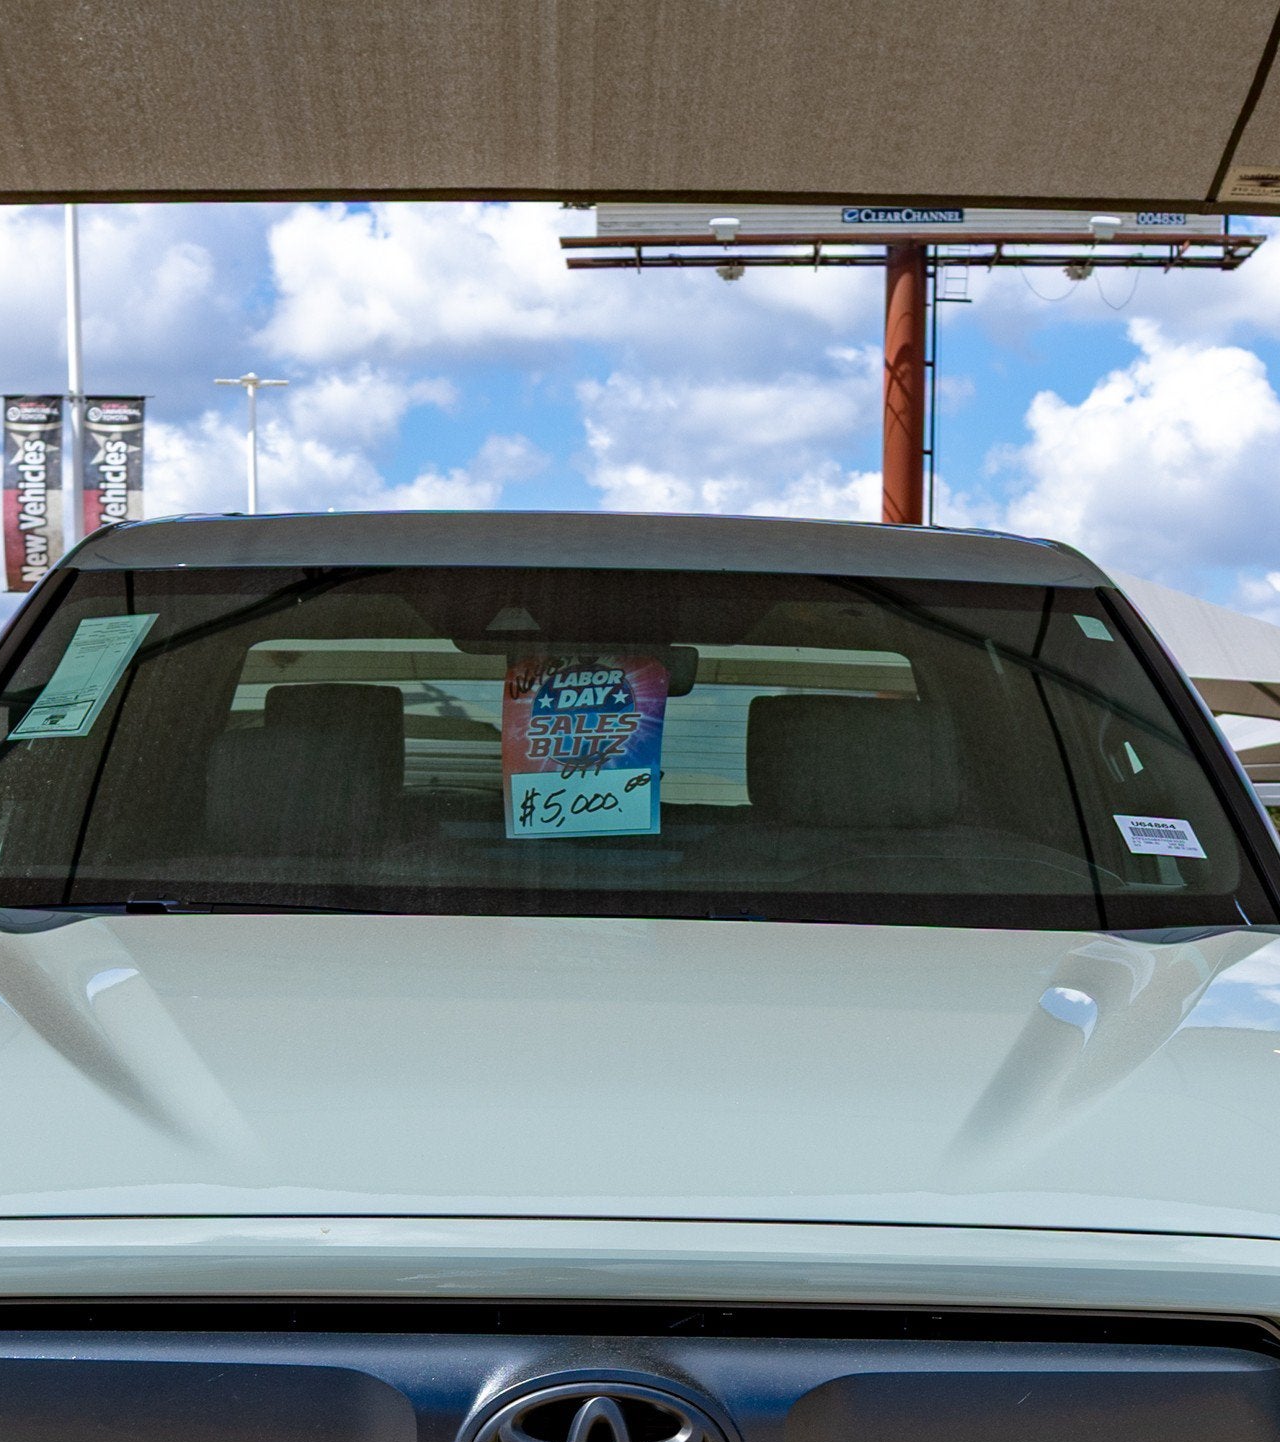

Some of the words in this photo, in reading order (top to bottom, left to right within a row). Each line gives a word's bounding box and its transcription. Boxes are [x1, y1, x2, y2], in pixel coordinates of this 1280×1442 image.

[18, 439, 47, 531] Vehicles
[22, 534, 49, 583] New
[552, 669, 624, 690] LABOR
[557, 686, 613, 710] DAY
[526, 712, 642, 737] SALES
[527, 734, 631, 759] BLITZ
